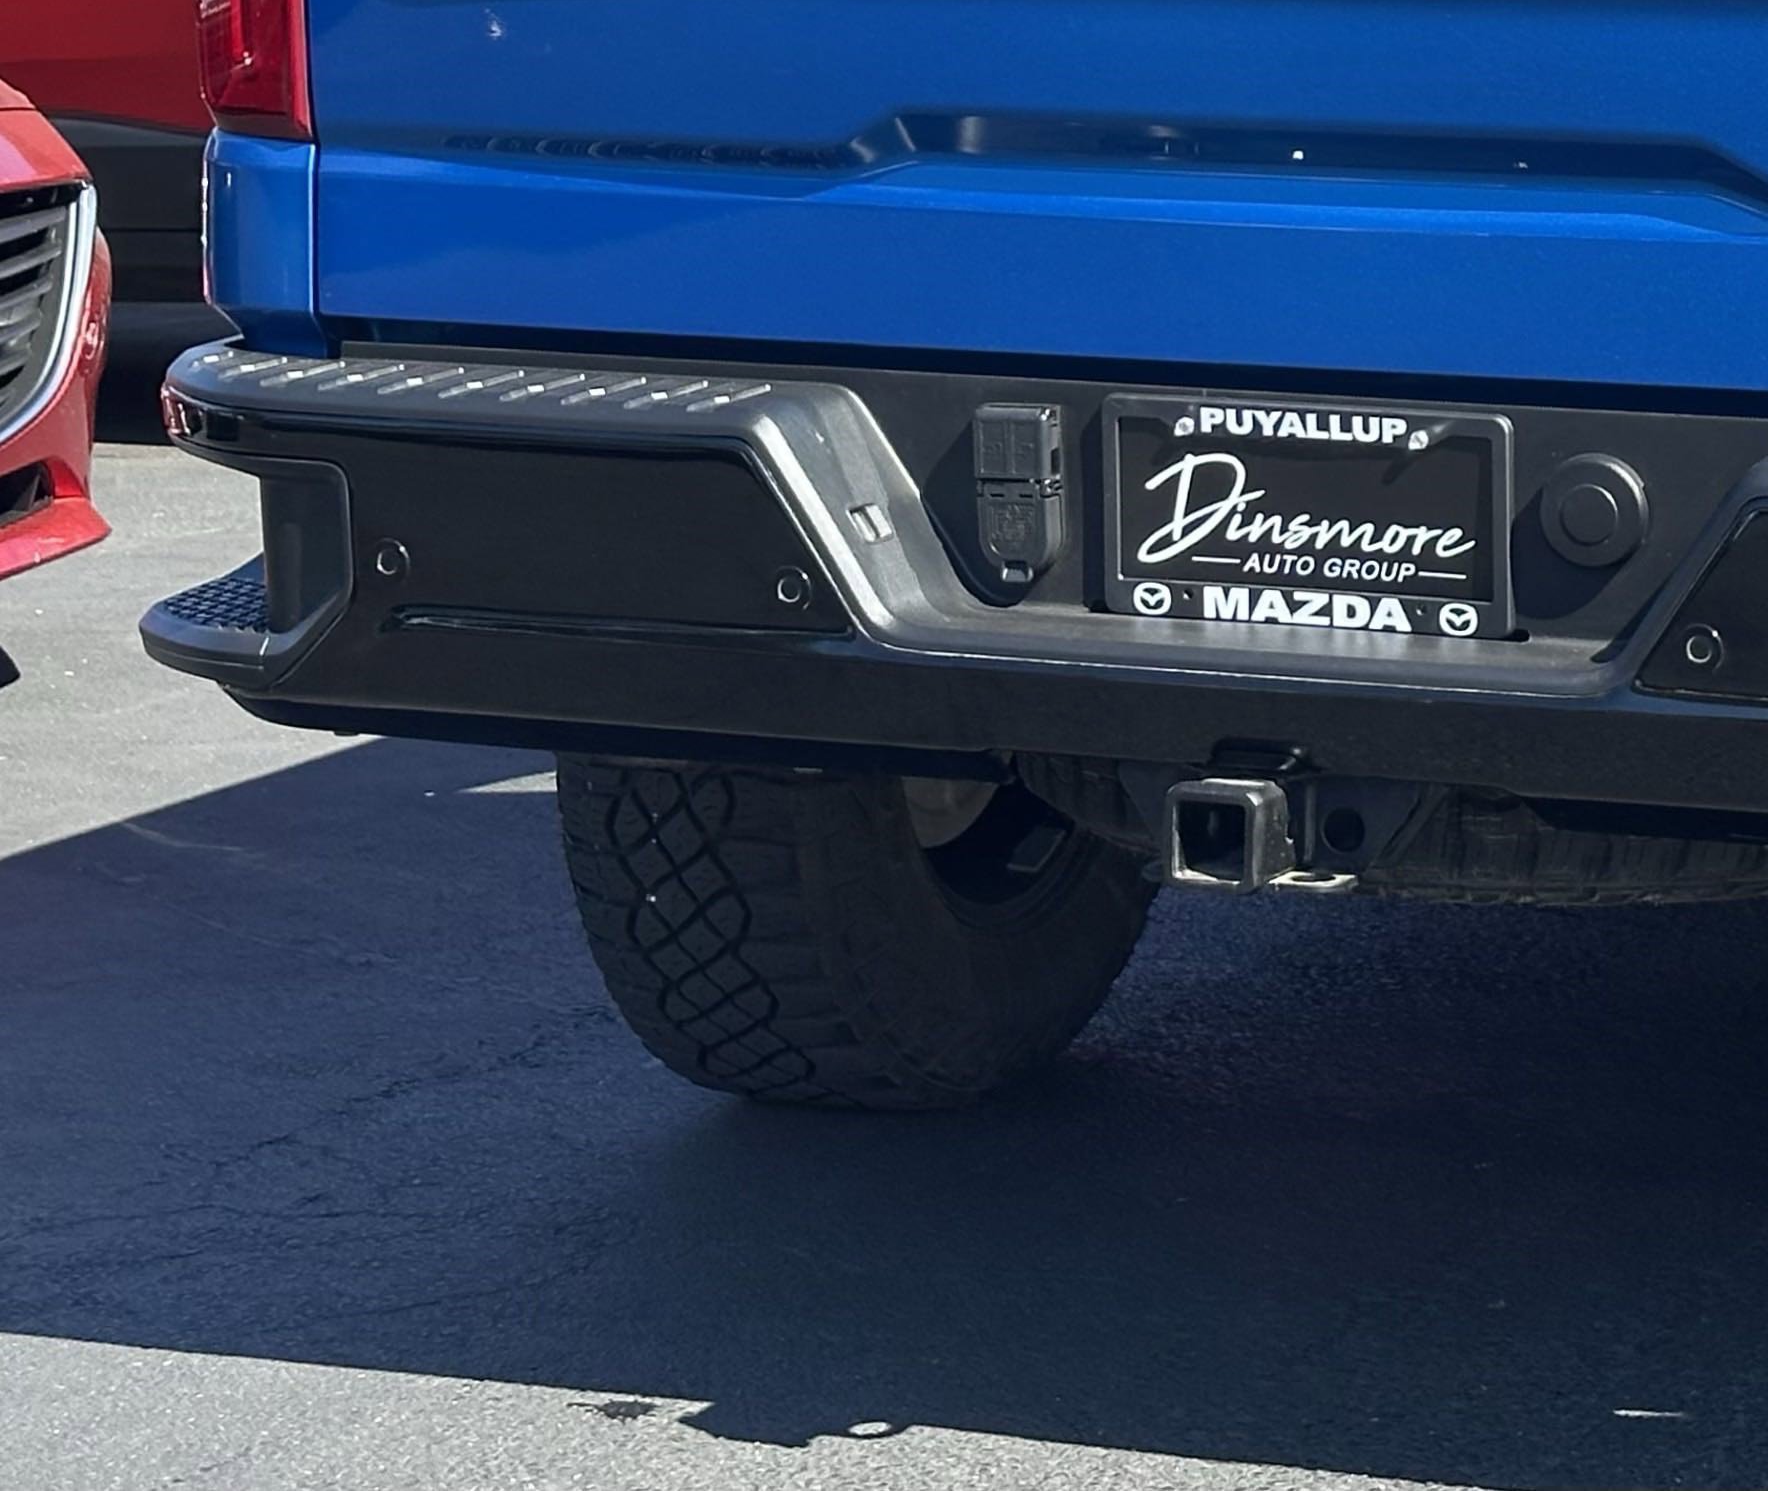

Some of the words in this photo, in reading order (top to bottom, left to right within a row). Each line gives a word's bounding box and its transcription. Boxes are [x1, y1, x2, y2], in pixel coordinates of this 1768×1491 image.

[1200, 406, 1408, 444] PUYALLUP
[1137, 452, 1476, 564] Dinsmore
[1243, 552, 1315, 576] AUTO
[1323, 557, 1416, 583] GROUP
[1203, 585, 1412, 633] MAZDA
